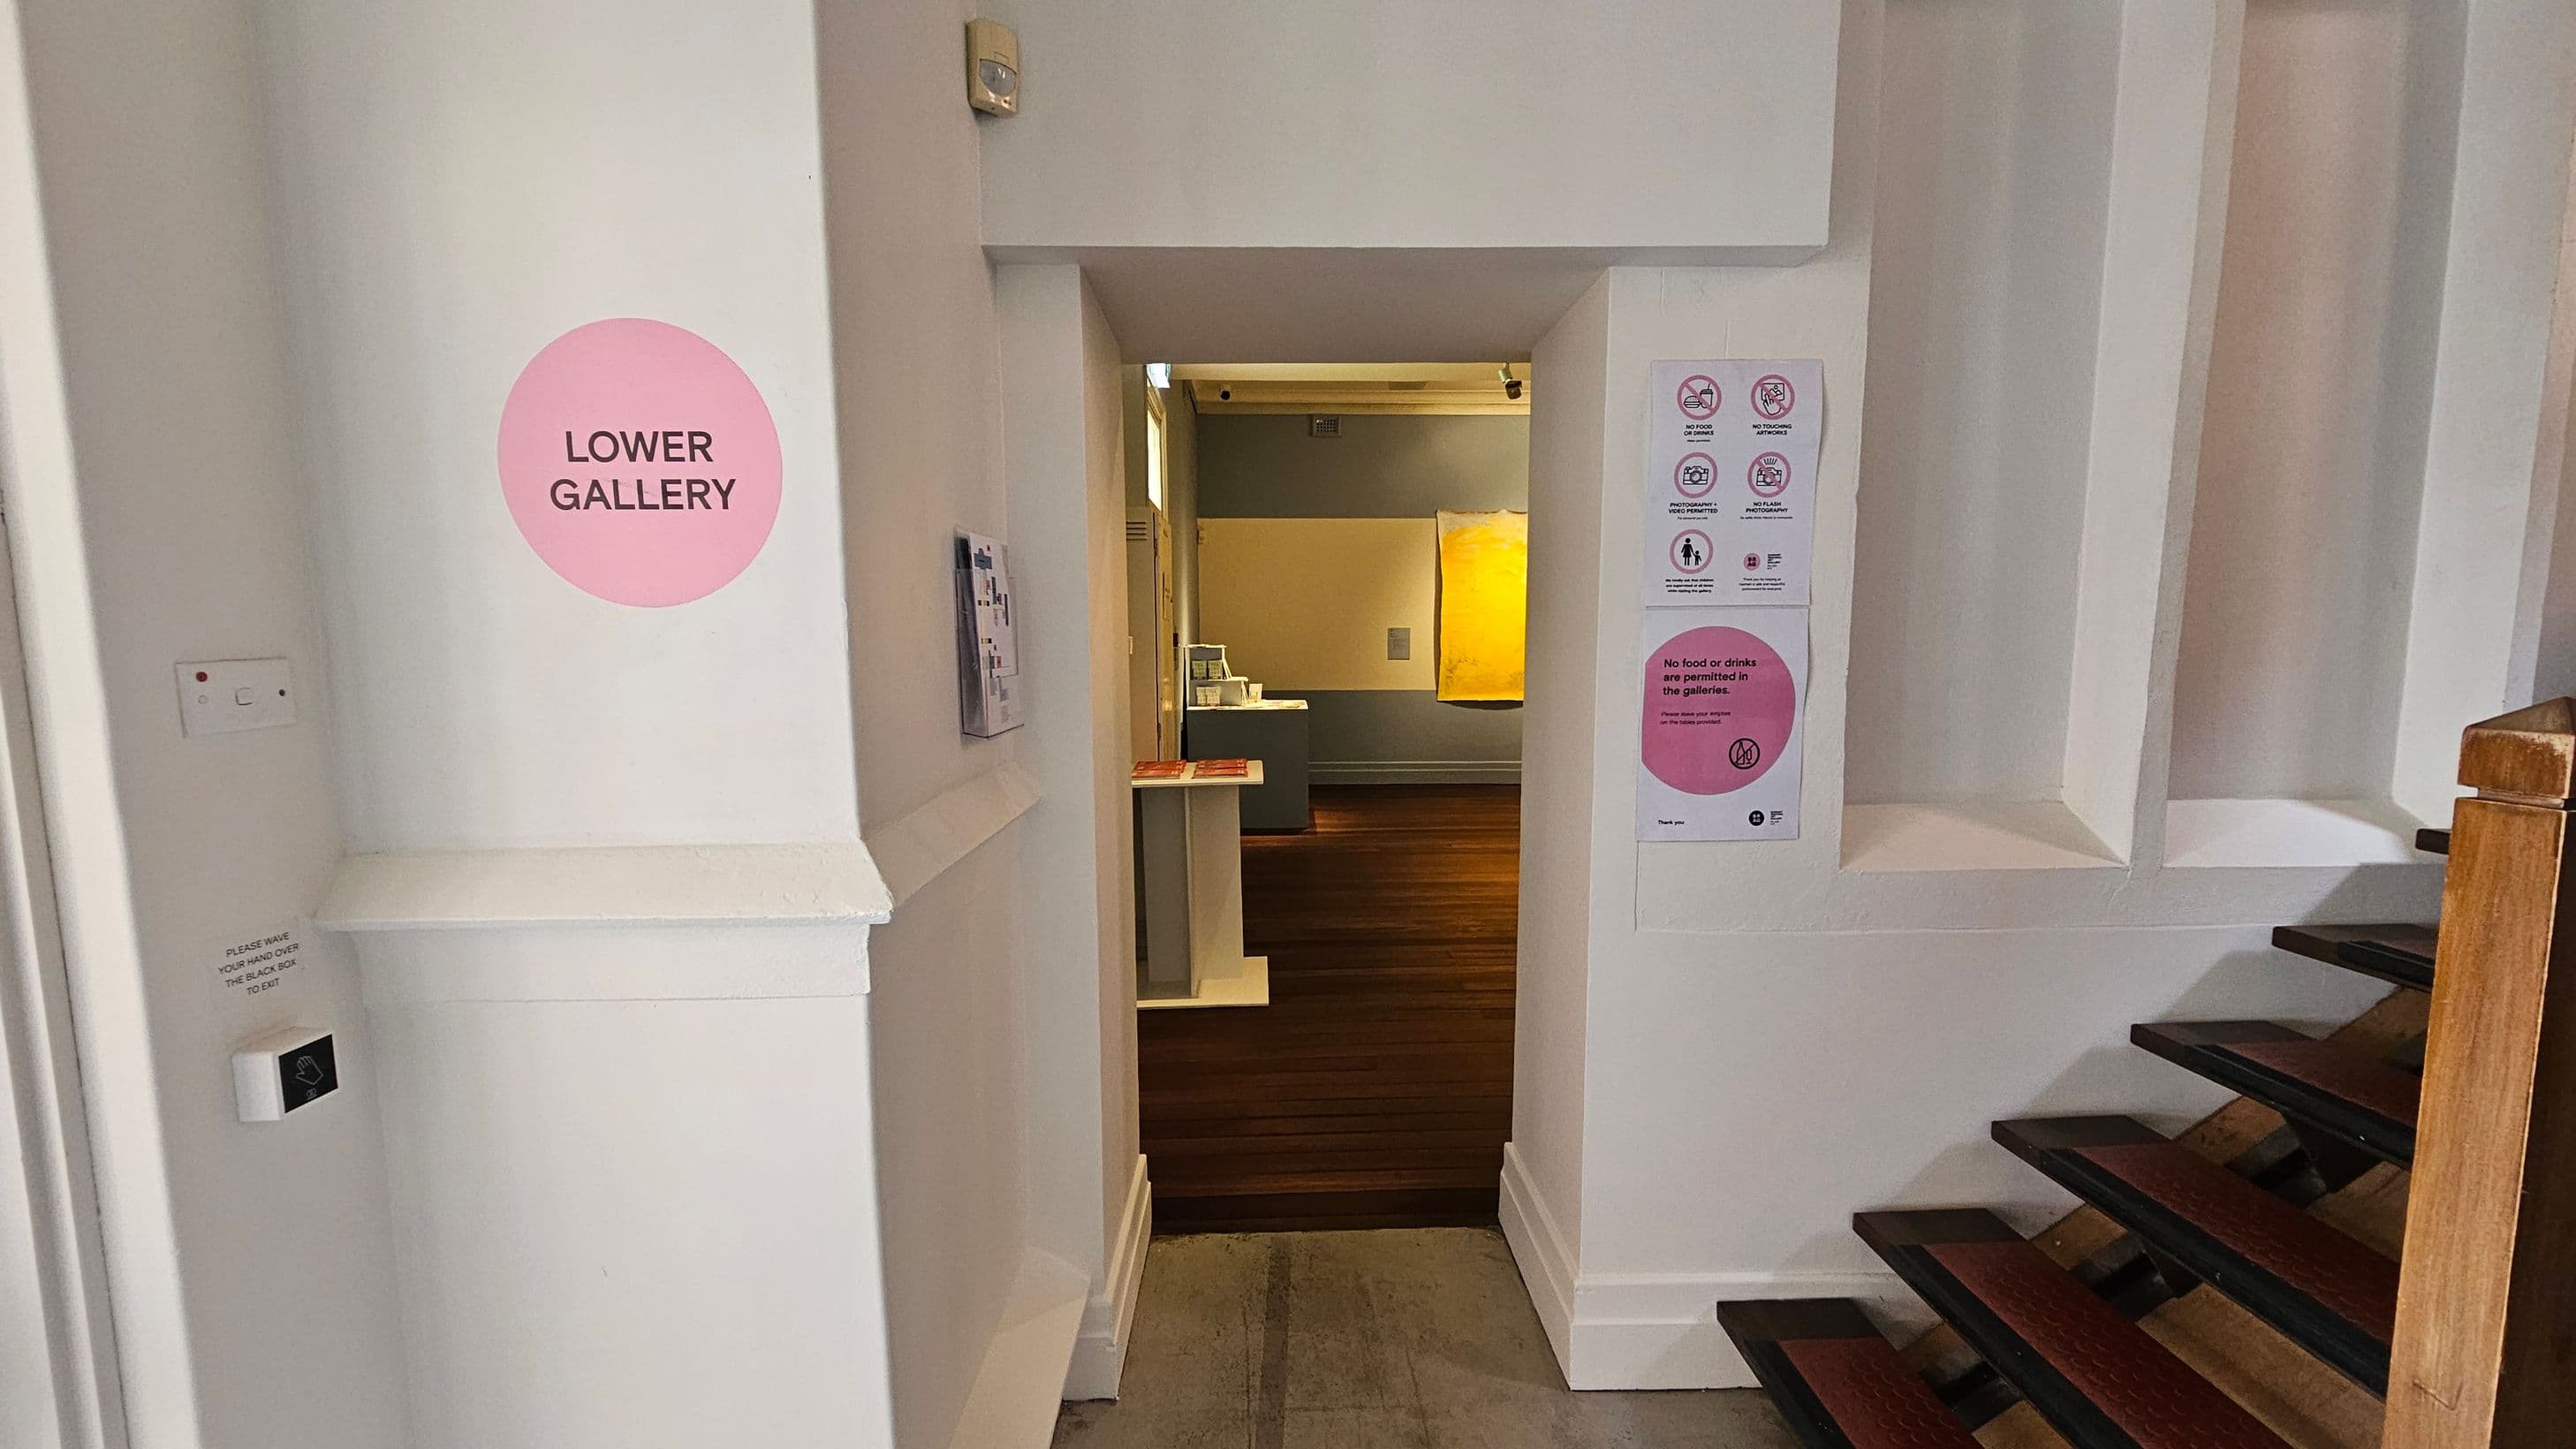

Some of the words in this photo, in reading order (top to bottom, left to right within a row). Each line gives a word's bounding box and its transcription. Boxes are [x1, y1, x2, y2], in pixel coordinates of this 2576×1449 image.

[565, 431, 714, 463] LOWER
[549, 479, 737, 511] GALLERY
[1663, 658, 1679, 668] No
[1682, 658, 1707, 668] food
[1724, 658, 1757, 668] drinks
[1683, 671, 1736, 684] permitted
[1739, 671, 1748, 681] in
[1663, 686, 1680, 695] the
[1683, 686, 1730, 697] galleries.
[226, 939, 262, 958] PLEASE
[263, 931, 290, 946] WAVE
[217, 960, 246, 975] YOUR
[247, 952, 273, 966] HAND
[275, 943, 299, 957] OVER
[224, 975, 245, 988] THE
[246, 964, 277, 982] BLACK
[277, 959, 297, 971] BOX
[246, 985, 260, 996] TO
[261, 977, 280, 990] EXIT
